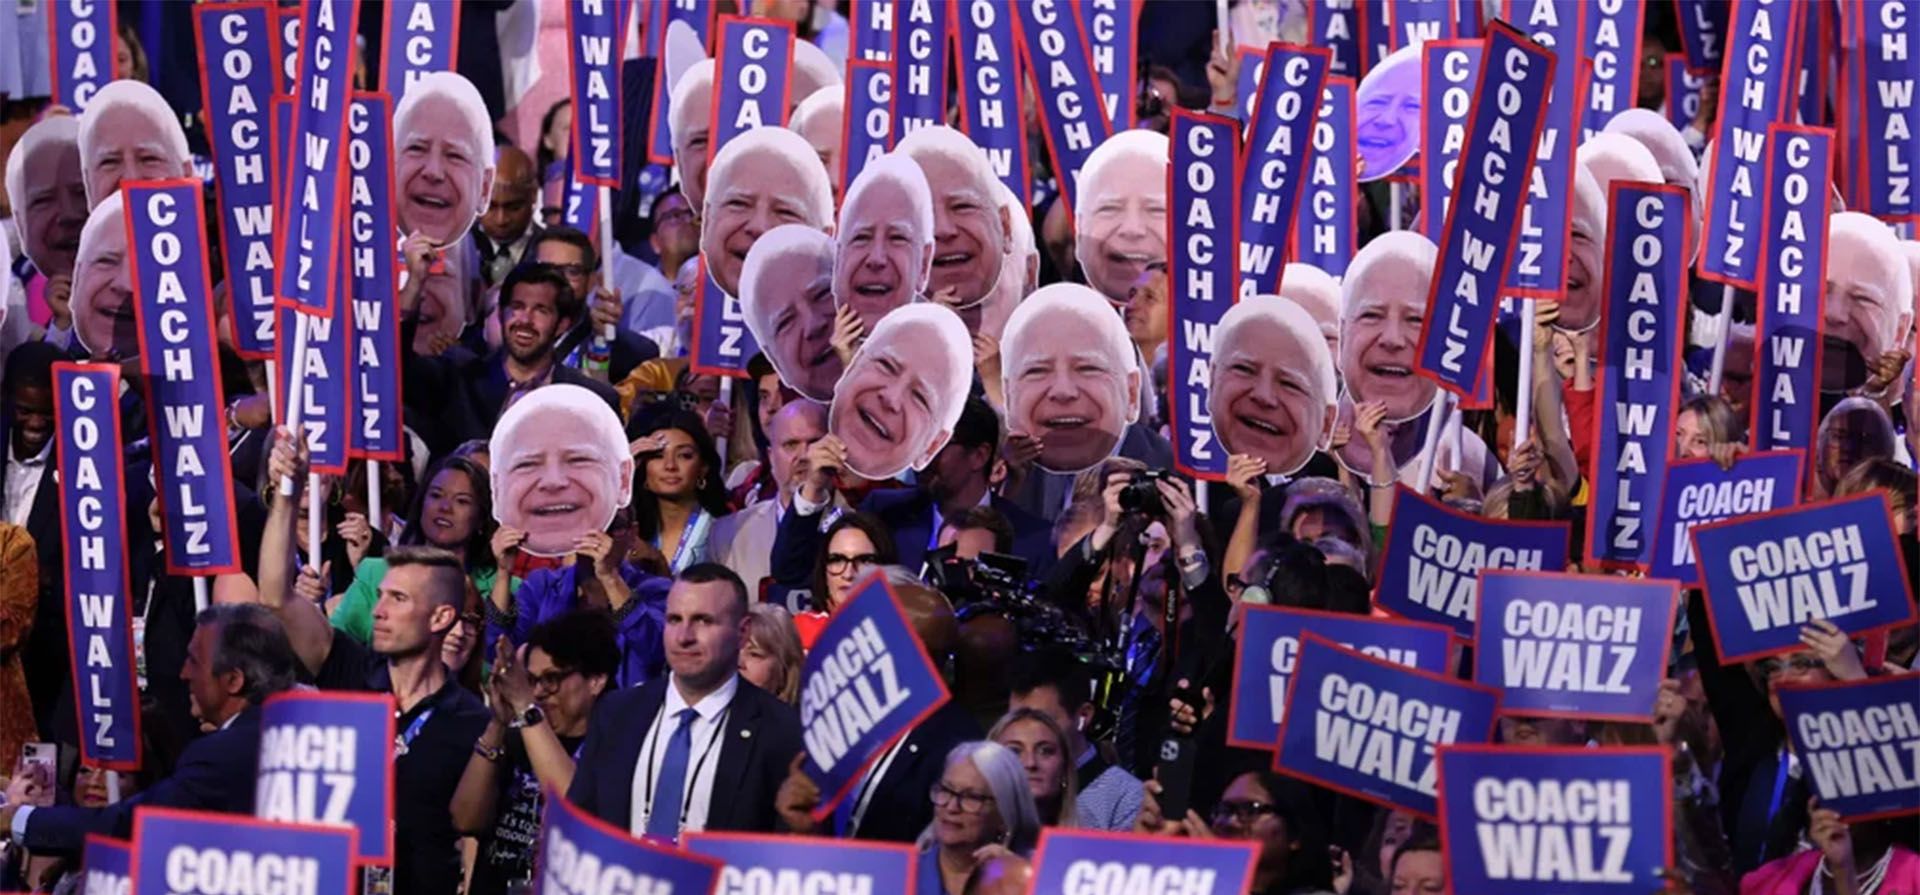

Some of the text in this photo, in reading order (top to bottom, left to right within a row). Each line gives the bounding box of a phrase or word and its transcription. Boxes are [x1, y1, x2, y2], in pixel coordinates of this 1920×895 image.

[70, 0, 98, 116] COAC
[581, 35, 612, 167] WALZ
[735, 29, 769, 130] COA
[908, 0, 933, 95] ACH
[971, 0, 1004, 128] OACH
[1031, 0, 1092, 150] COACH
[1591, 0, 1622, 112] OACH
[296, 0, 335, 291] ACH WALZ
[866, 72, 891, 166] COA
[1251, 56, 1310, 224] COACH
[1723, 0, 1774, 267] ACH WALZ
[1877, 79, 1914, 205] WALZ
[219, 14, 275, 340] COACH WALZ
[348, 103, 375, 278] COACH
[1187, 125, 1215, 301] COACH
[1440, 47, 1529, 373] COACH WALZ
[1771, 137, 1811, 451] COACH WAL
[147, 192, 210, 556] COACH WALZ
[352, 299, 381, 438] WALZ
[1183, 319, 1217, 460] WALZ
[1613, 196, 1664, 549] COACH WALZ
[1678, 477, 1776, 519] COACH
[1729, 524, 1866, 583] COACH
[71, 376, 115, 747] COACH WALZ
[1408, 555, 1477, 622] WA
[1736, 562, 1878, 633] WALZ
[801, 617, 887, 727] COACH
[1501, 638, 1637, 694] WALZ
[1504, 598, 1641, 643] COACH
[260, 724, 357, 773] ACH
[803, 652, 911, 774] WALZ
[1315, 709, 1440, 798] WALZ
[1319, 673, 1462, 745] COACH
[1797, 702, 1920, 750] COACH
[256, 770, 357, 828] ALZ
[1473, 777, 1632, 823] COACH
[1475, 822, 1634, 883] WALZ
[166, 844, 319, 895] COACH
[1062, 860, 1217, 895] COACH
